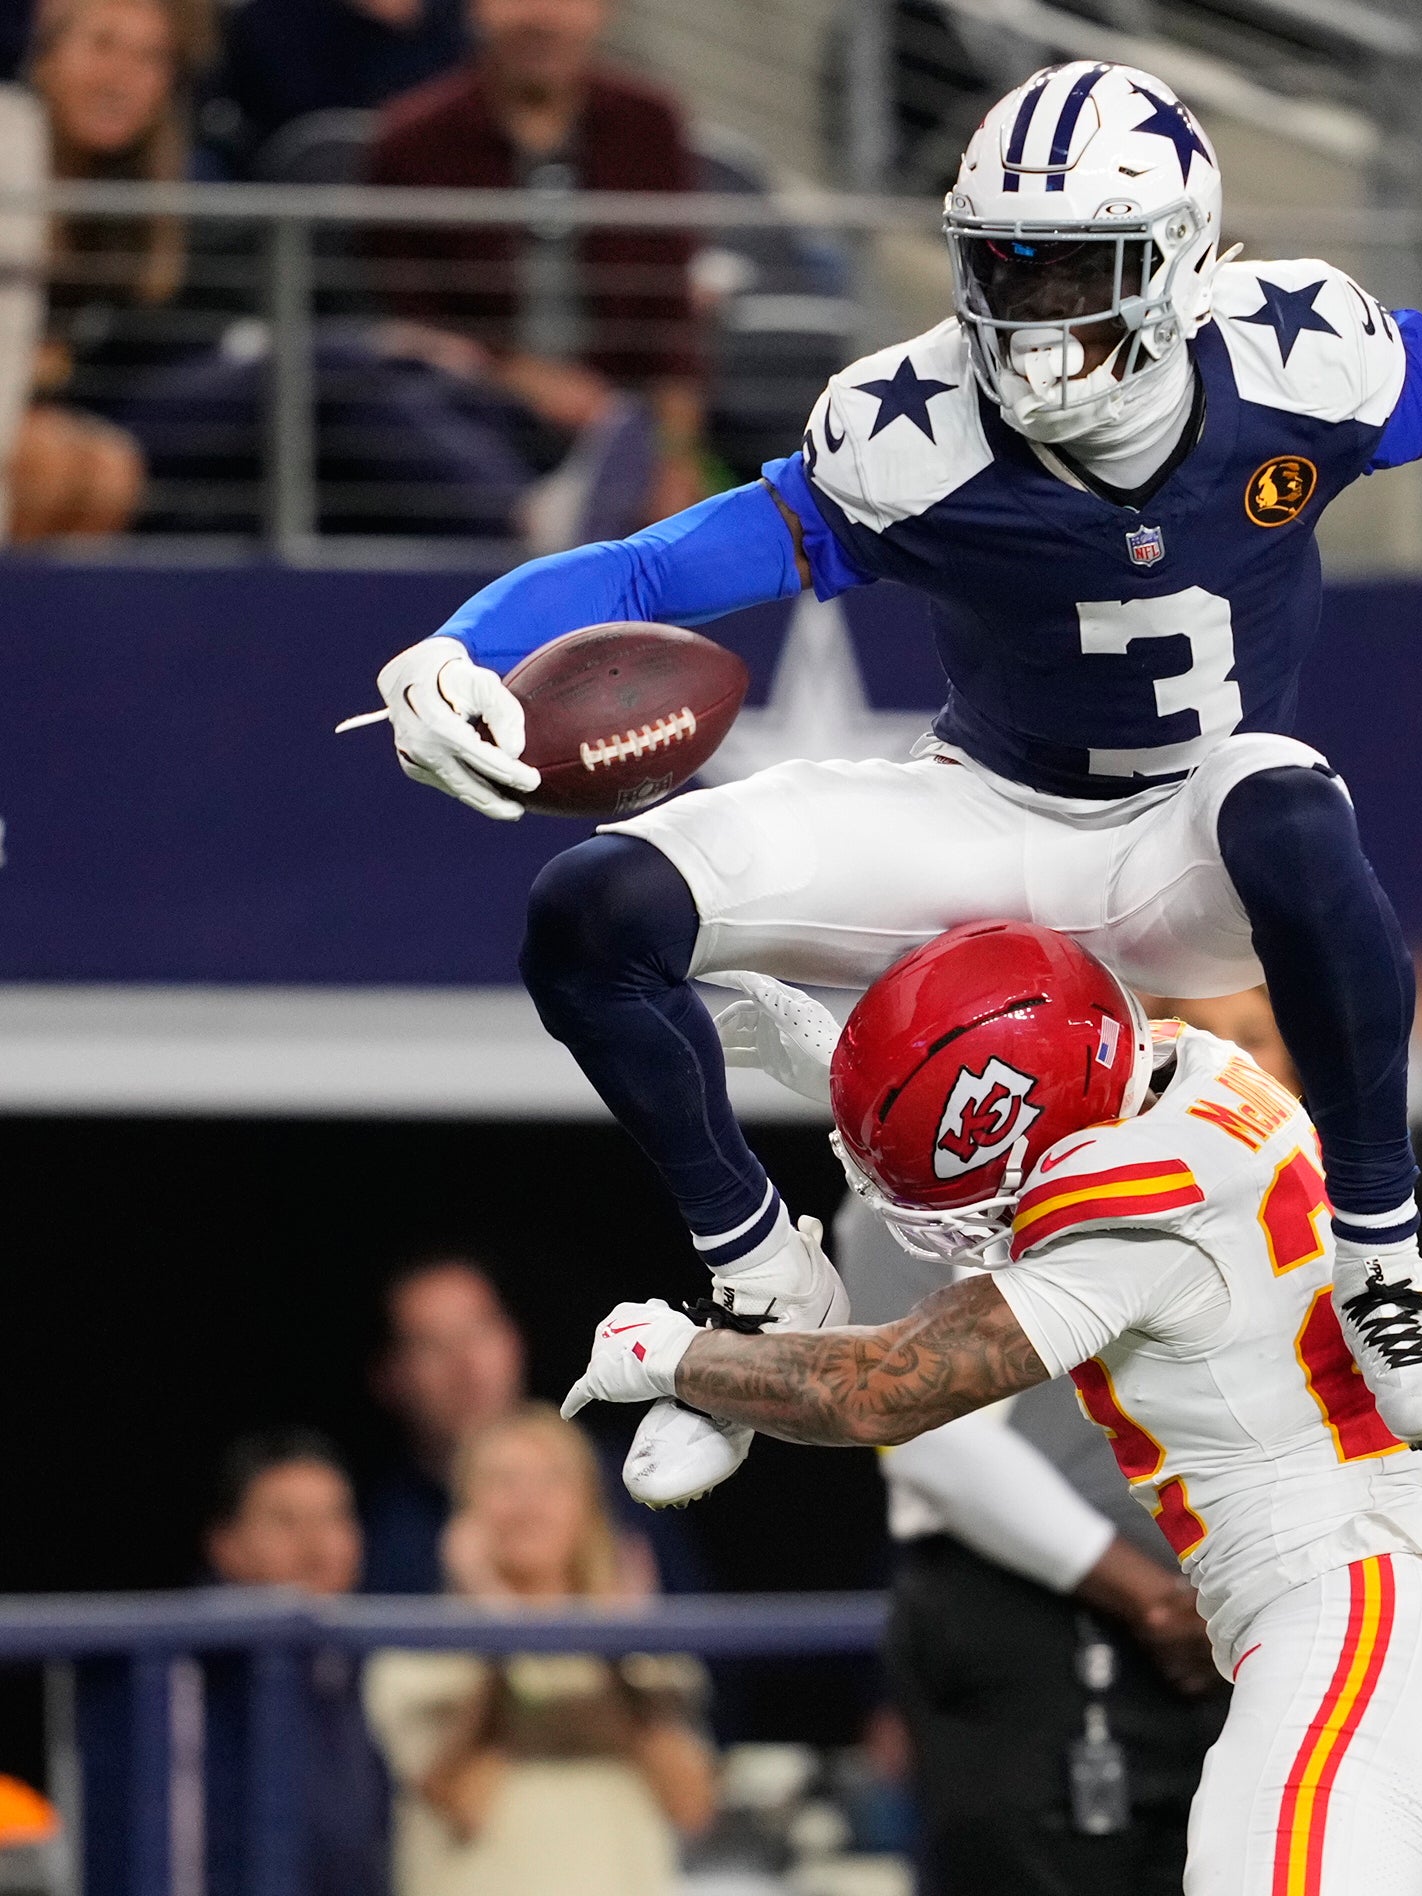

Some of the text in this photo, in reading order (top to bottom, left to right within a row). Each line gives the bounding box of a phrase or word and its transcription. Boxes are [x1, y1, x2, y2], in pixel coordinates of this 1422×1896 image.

[1134, 545, 1160, 560] NFL
[1075, 585, 1243, 777] 3
[938, 1081, 1022, 1164] KC
